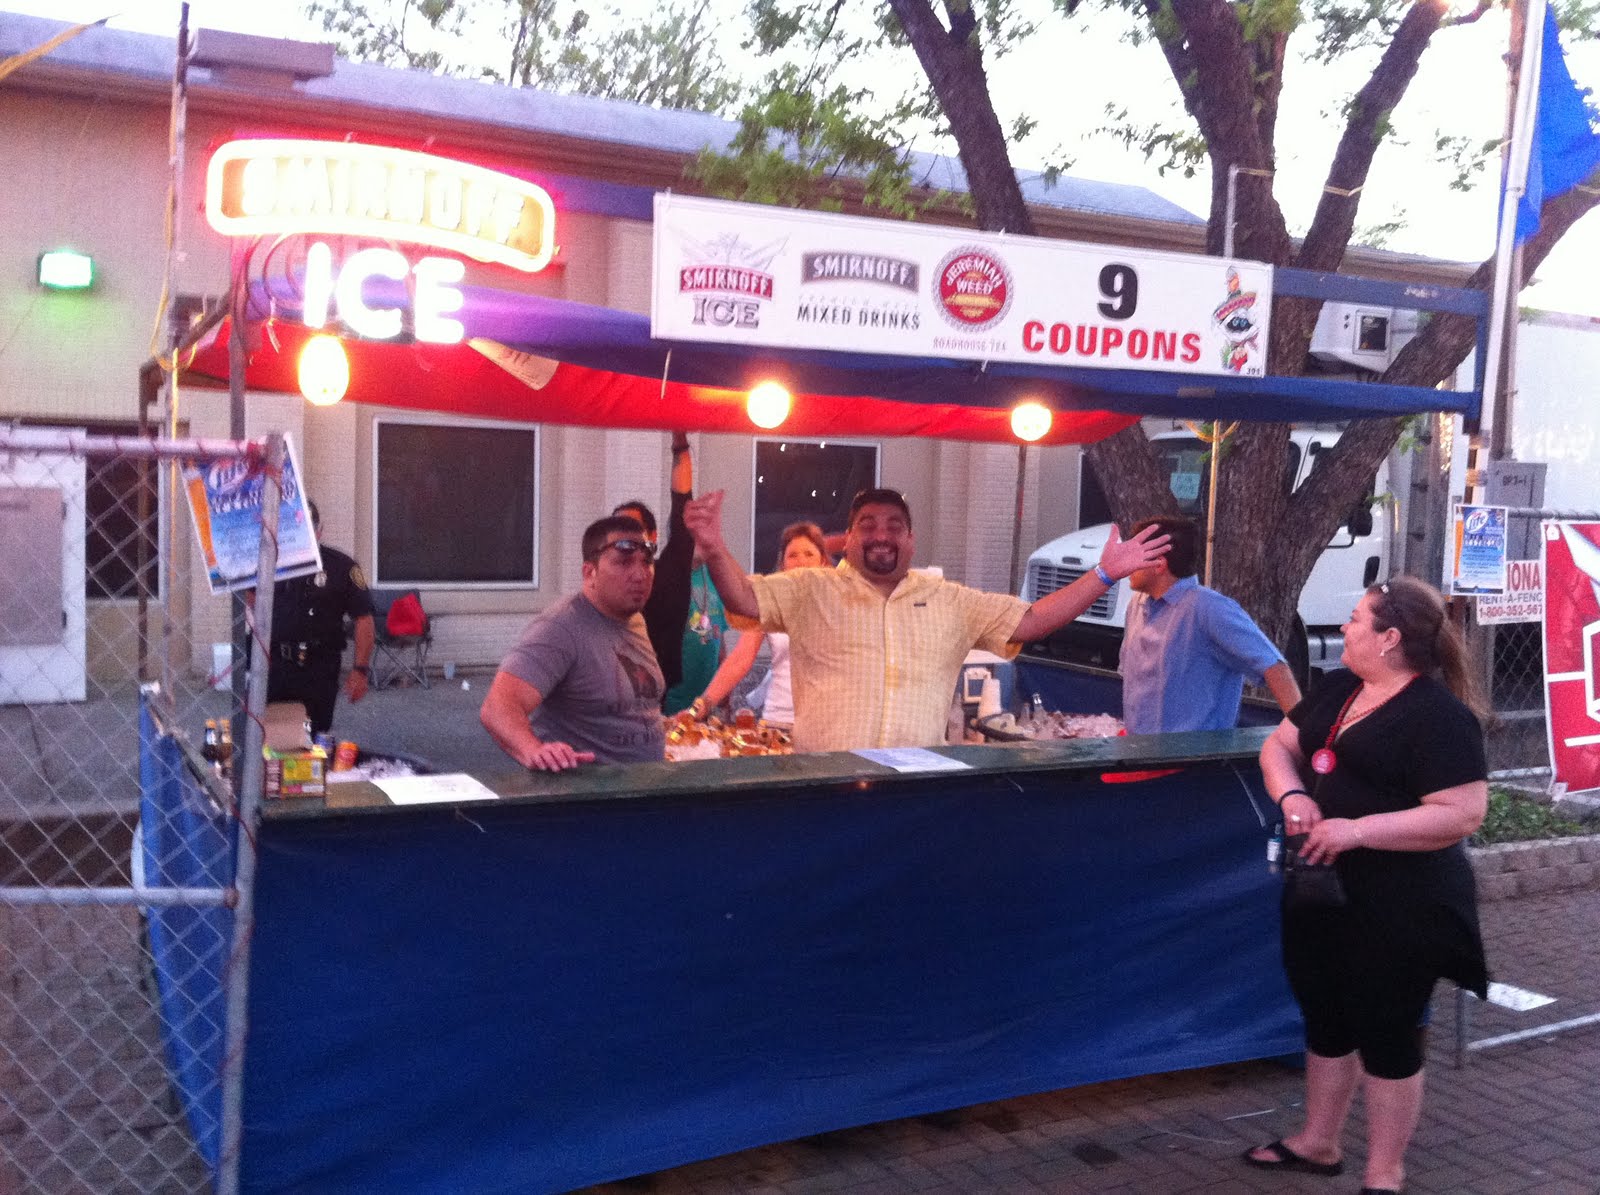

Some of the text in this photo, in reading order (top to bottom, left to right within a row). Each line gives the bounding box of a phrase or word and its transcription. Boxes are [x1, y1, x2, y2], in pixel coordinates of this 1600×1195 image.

[682, 267, 771, 298] SMIRNOFF
[812, 255, 912, 285] SMIRNOFF
[945, 256, 1004, 289] JEREMIAH
[956, 278, 994, 295] WEED
[303, 241, 466, 344] ICE
[1097, 262, 1139, 321] 9
[692, 296, 760, 329] ICE
[797, 303, 921, 331] MIXED DRINKS
[1022, 320, 1202, 364] COUPONS
